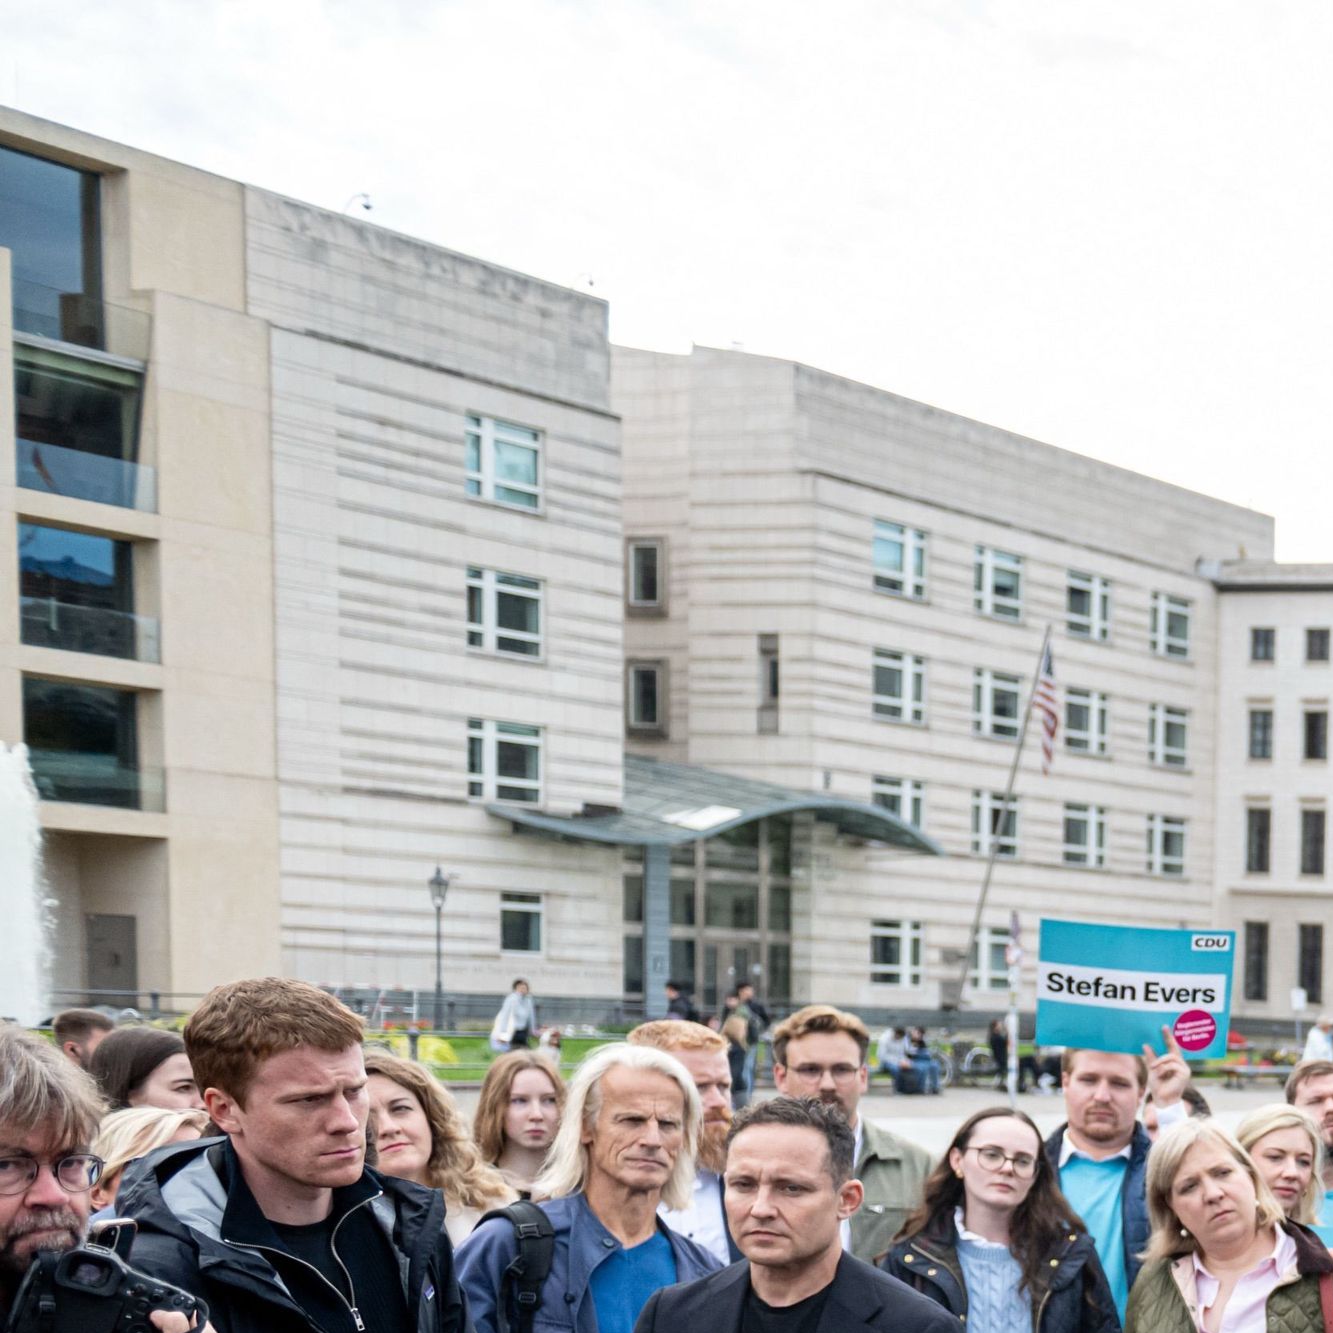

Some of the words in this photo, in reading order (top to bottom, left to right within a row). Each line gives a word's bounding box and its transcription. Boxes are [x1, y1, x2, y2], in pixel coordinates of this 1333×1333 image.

[1195, 937, 1227, 949] CDU
[1046, 972, 1136, 1001] Stefan
[1143, 981, 1216, 1003] Evers
